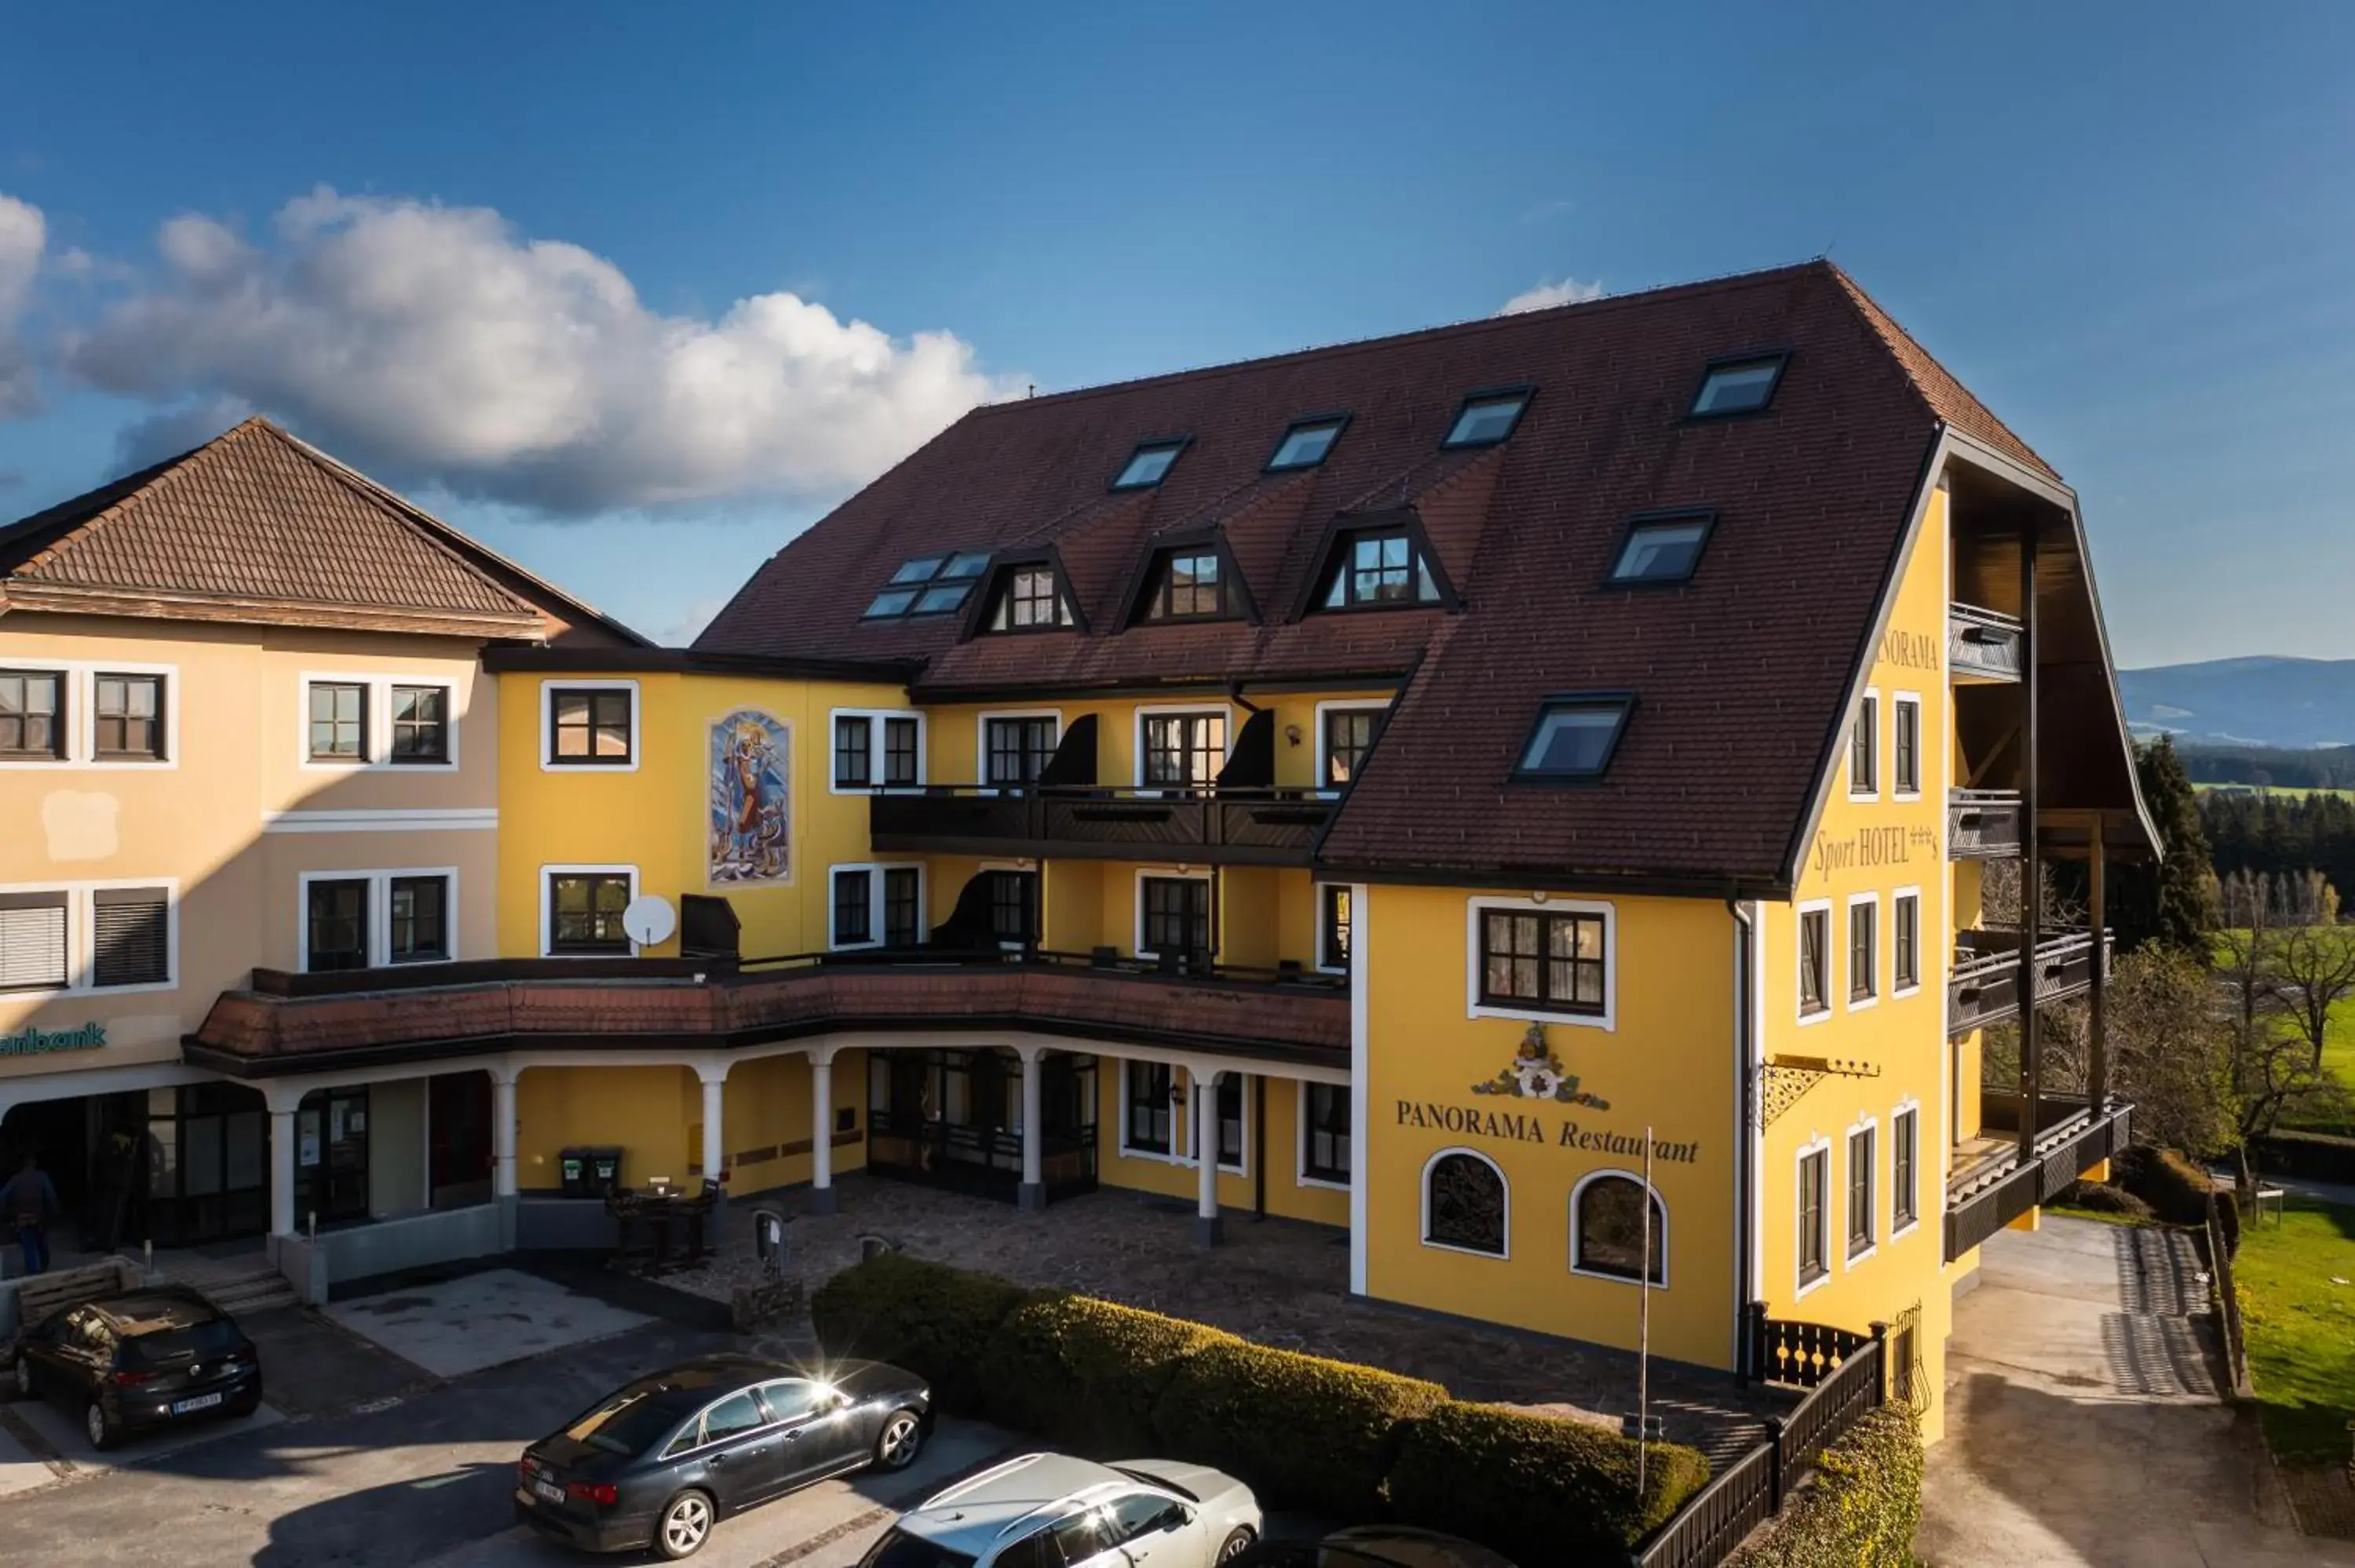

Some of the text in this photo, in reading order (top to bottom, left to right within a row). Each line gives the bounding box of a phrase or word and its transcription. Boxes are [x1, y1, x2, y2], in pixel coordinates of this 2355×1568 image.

[1814, 830, 1855, 882] Sport
[1859, 826, 1909, 866] HOTEL
[1397, 1100, 1544, 1143] PANORAMA
